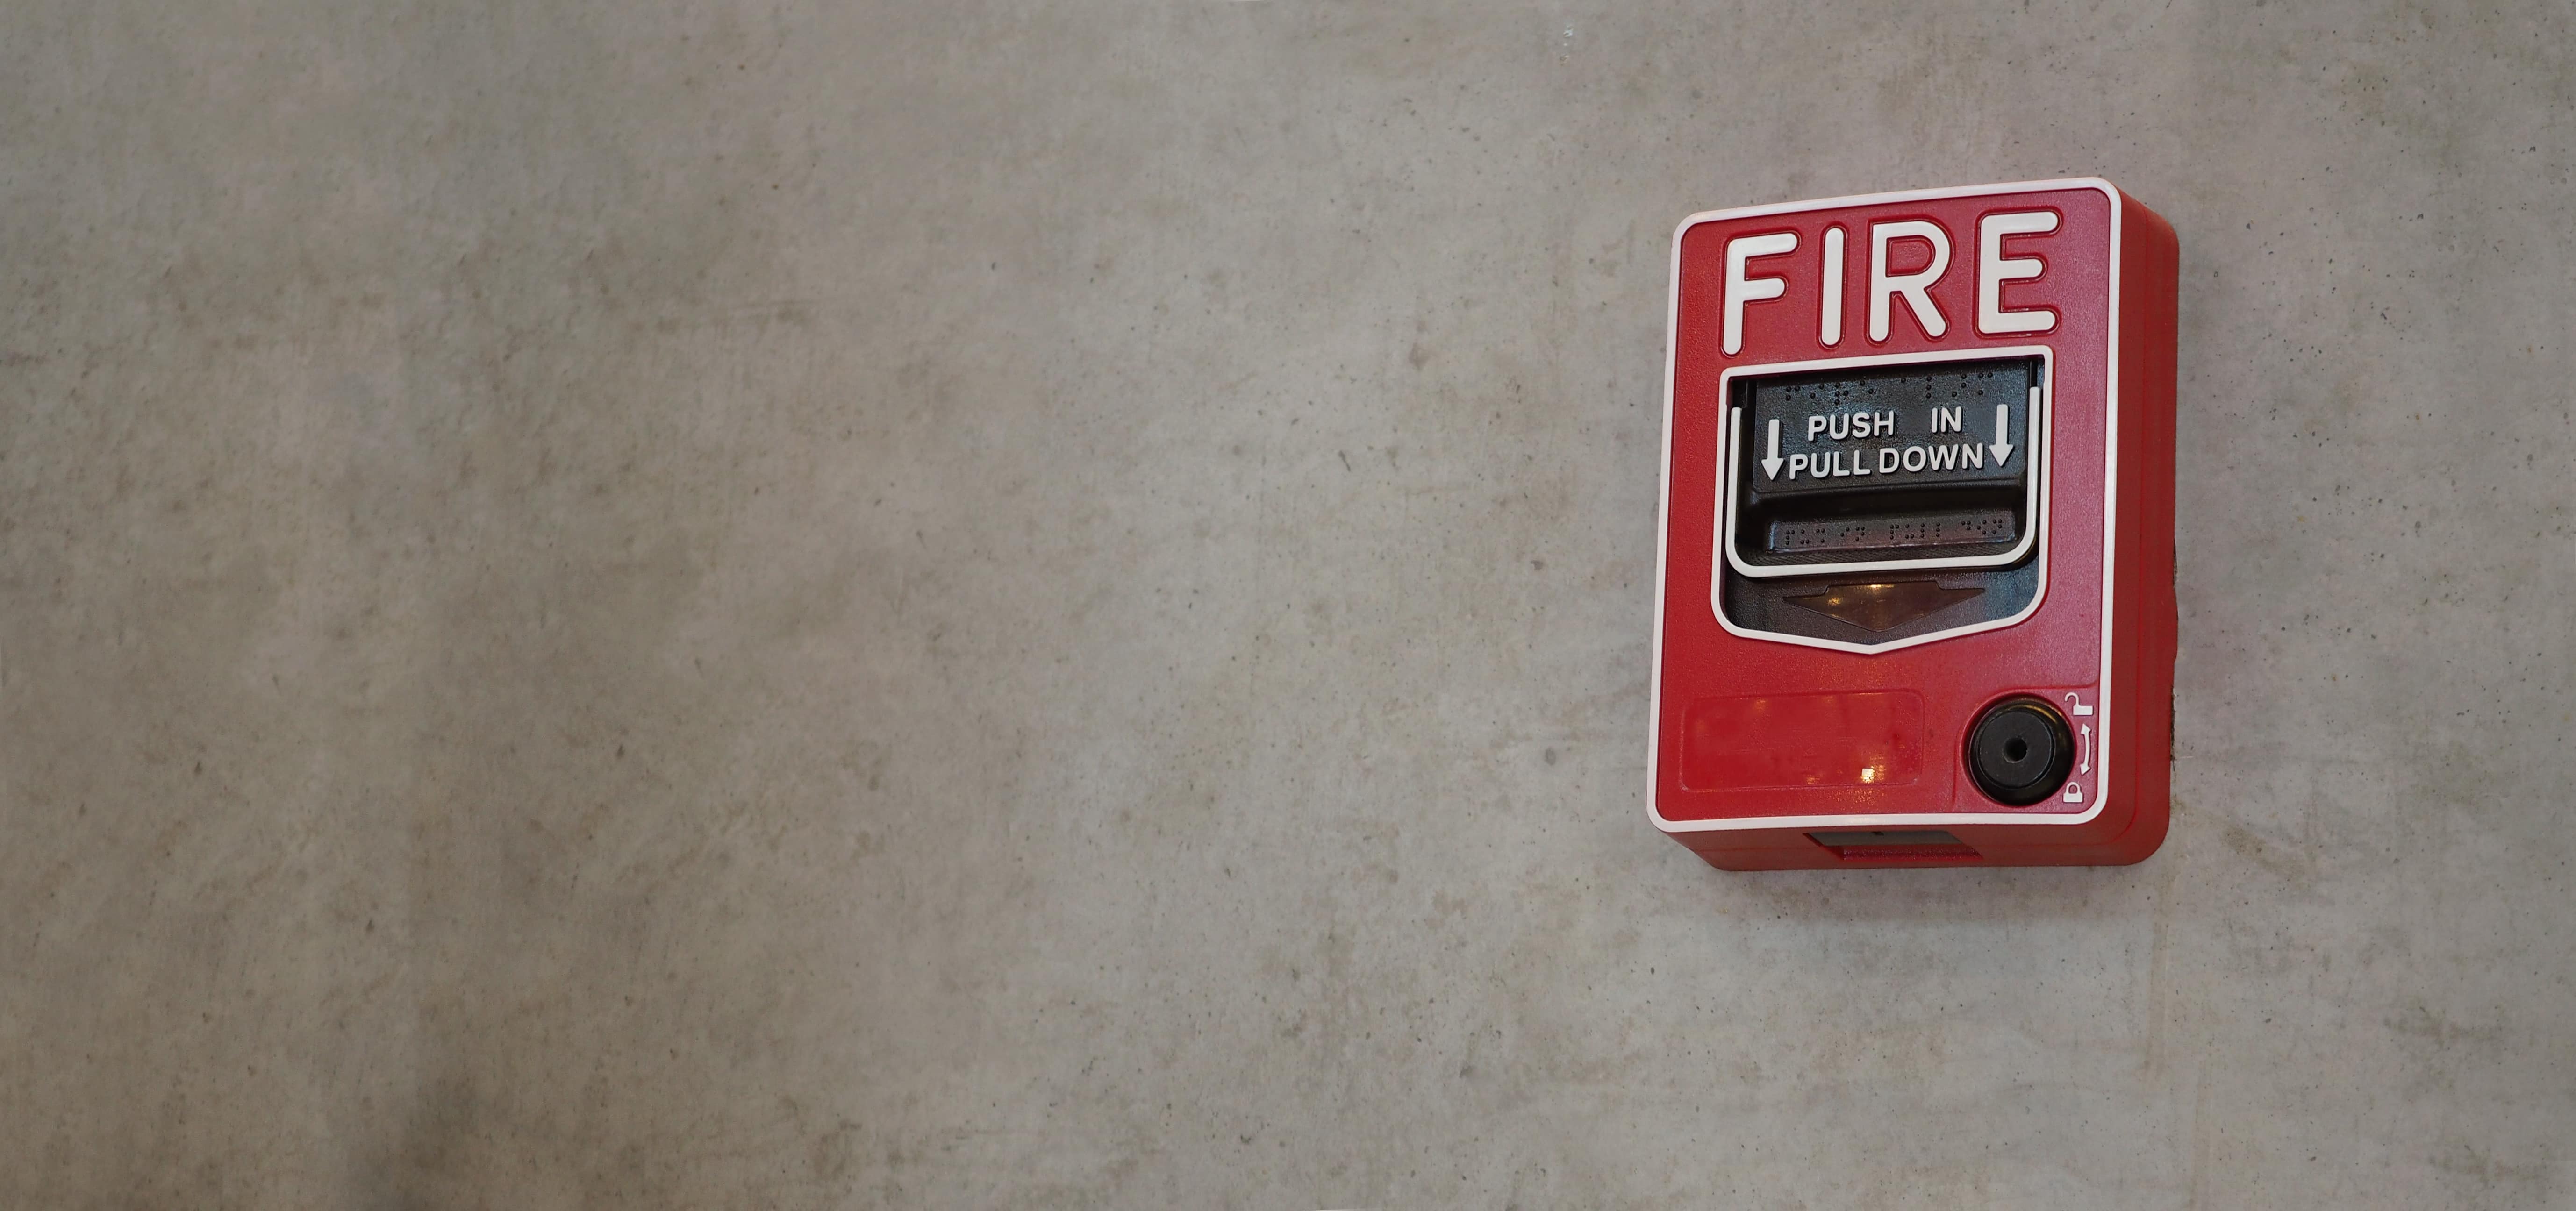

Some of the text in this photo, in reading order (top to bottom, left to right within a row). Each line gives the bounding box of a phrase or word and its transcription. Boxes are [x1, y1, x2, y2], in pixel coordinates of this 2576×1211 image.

[1722, 211, 2059, 355] FIRE
[1808, 406, 1962, 441] PUSH IN
[1789, 443, 1983, 479] PULL DOWN
